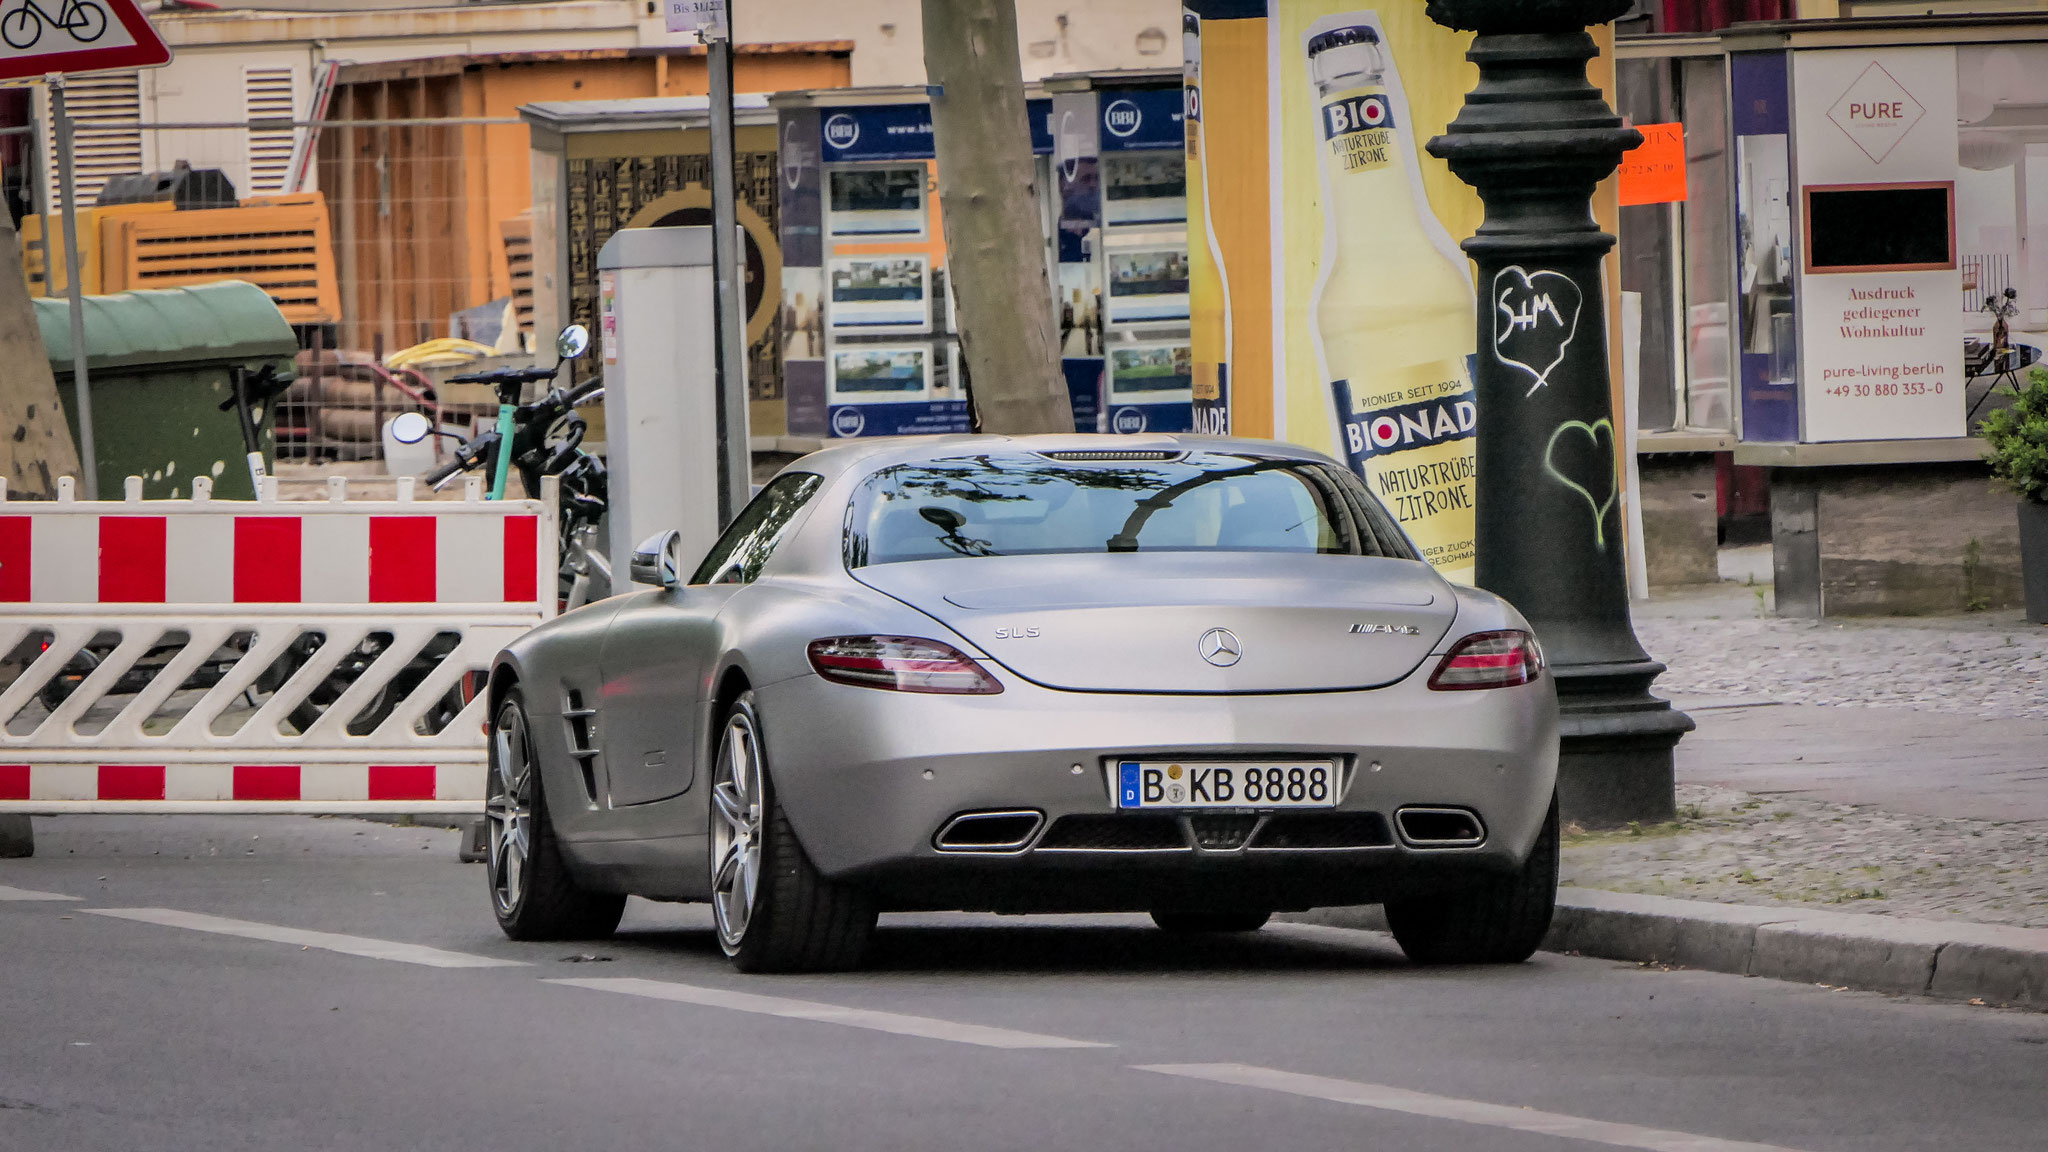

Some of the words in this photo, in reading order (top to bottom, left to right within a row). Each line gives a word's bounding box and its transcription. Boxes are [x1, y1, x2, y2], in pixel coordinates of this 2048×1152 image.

[673, 3, 690, 14] Bis
[1111, 111, 1135, 125] BBI
[1328, 98, 1386, 133] BIO
[1850, 102, 1904, 119] PURE
[1342, 147, 1388, 170] ZITRONE
[1848, 286, 1915, 300] Ausdruck
[1843, 306, 1921, 322] gediegener
[1840, 325, 1926, 338] Wohnkultur
[1823, 362, 1944, 381] pure-living.berlin
[1362, 391, 1404, 407] PIONIER
[1407, 384, 1433, 399] SEIT
[1438, 380, 1462, 393] 1994
[1825, 385, 1850, 397] +49
[1854, 384, 1870, 397] 30
[1875, 383, 1898, 396] 880
[1902, 382, 1944, 396] 353-0
[1346, 401, 1477, 454] BIONAD
[1378, 455, 1477, 495] NATURTRÜBE
[1395, 484, 1473, 522] ZITRONE
[1421, 545, 1445, 557] IGER
[1447, 540, 1475, 552] ZUCK
[995, 626, 1041, 639] SLS
[1144, 769, 1165, 802] B
[1190, 768, 1234, 802] KB
[1244, 767, 1328, 802] 8888
[1126, 790, 1135, 800] D
